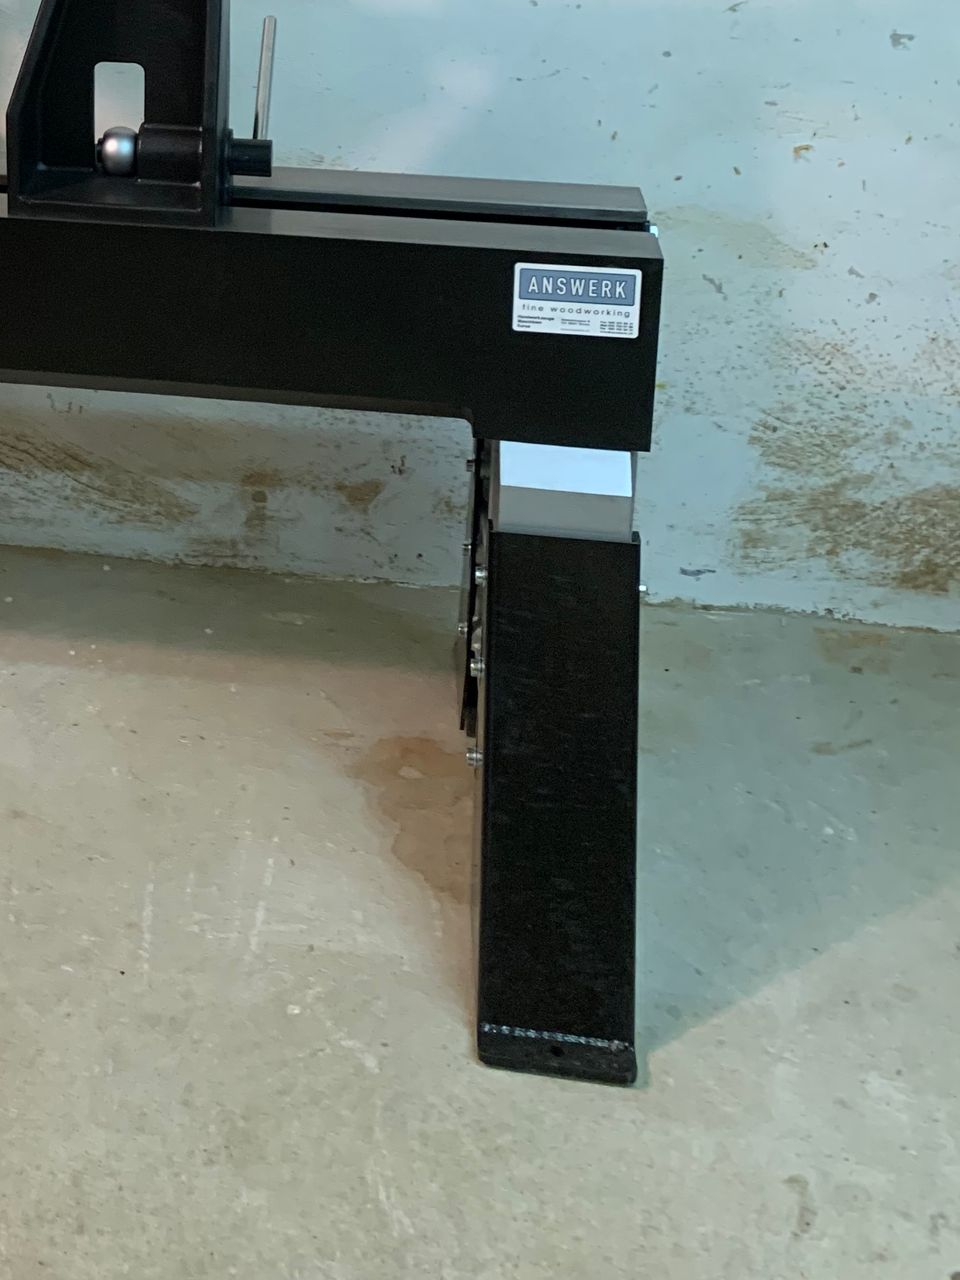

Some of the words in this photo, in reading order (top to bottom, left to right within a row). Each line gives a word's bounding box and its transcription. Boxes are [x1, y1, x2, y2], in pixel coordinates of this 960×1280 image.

[528, 276, 627, 299] ANSWERK
[522, 304, 544, 312] fine
[550, 306, 631, 318] woodworking
